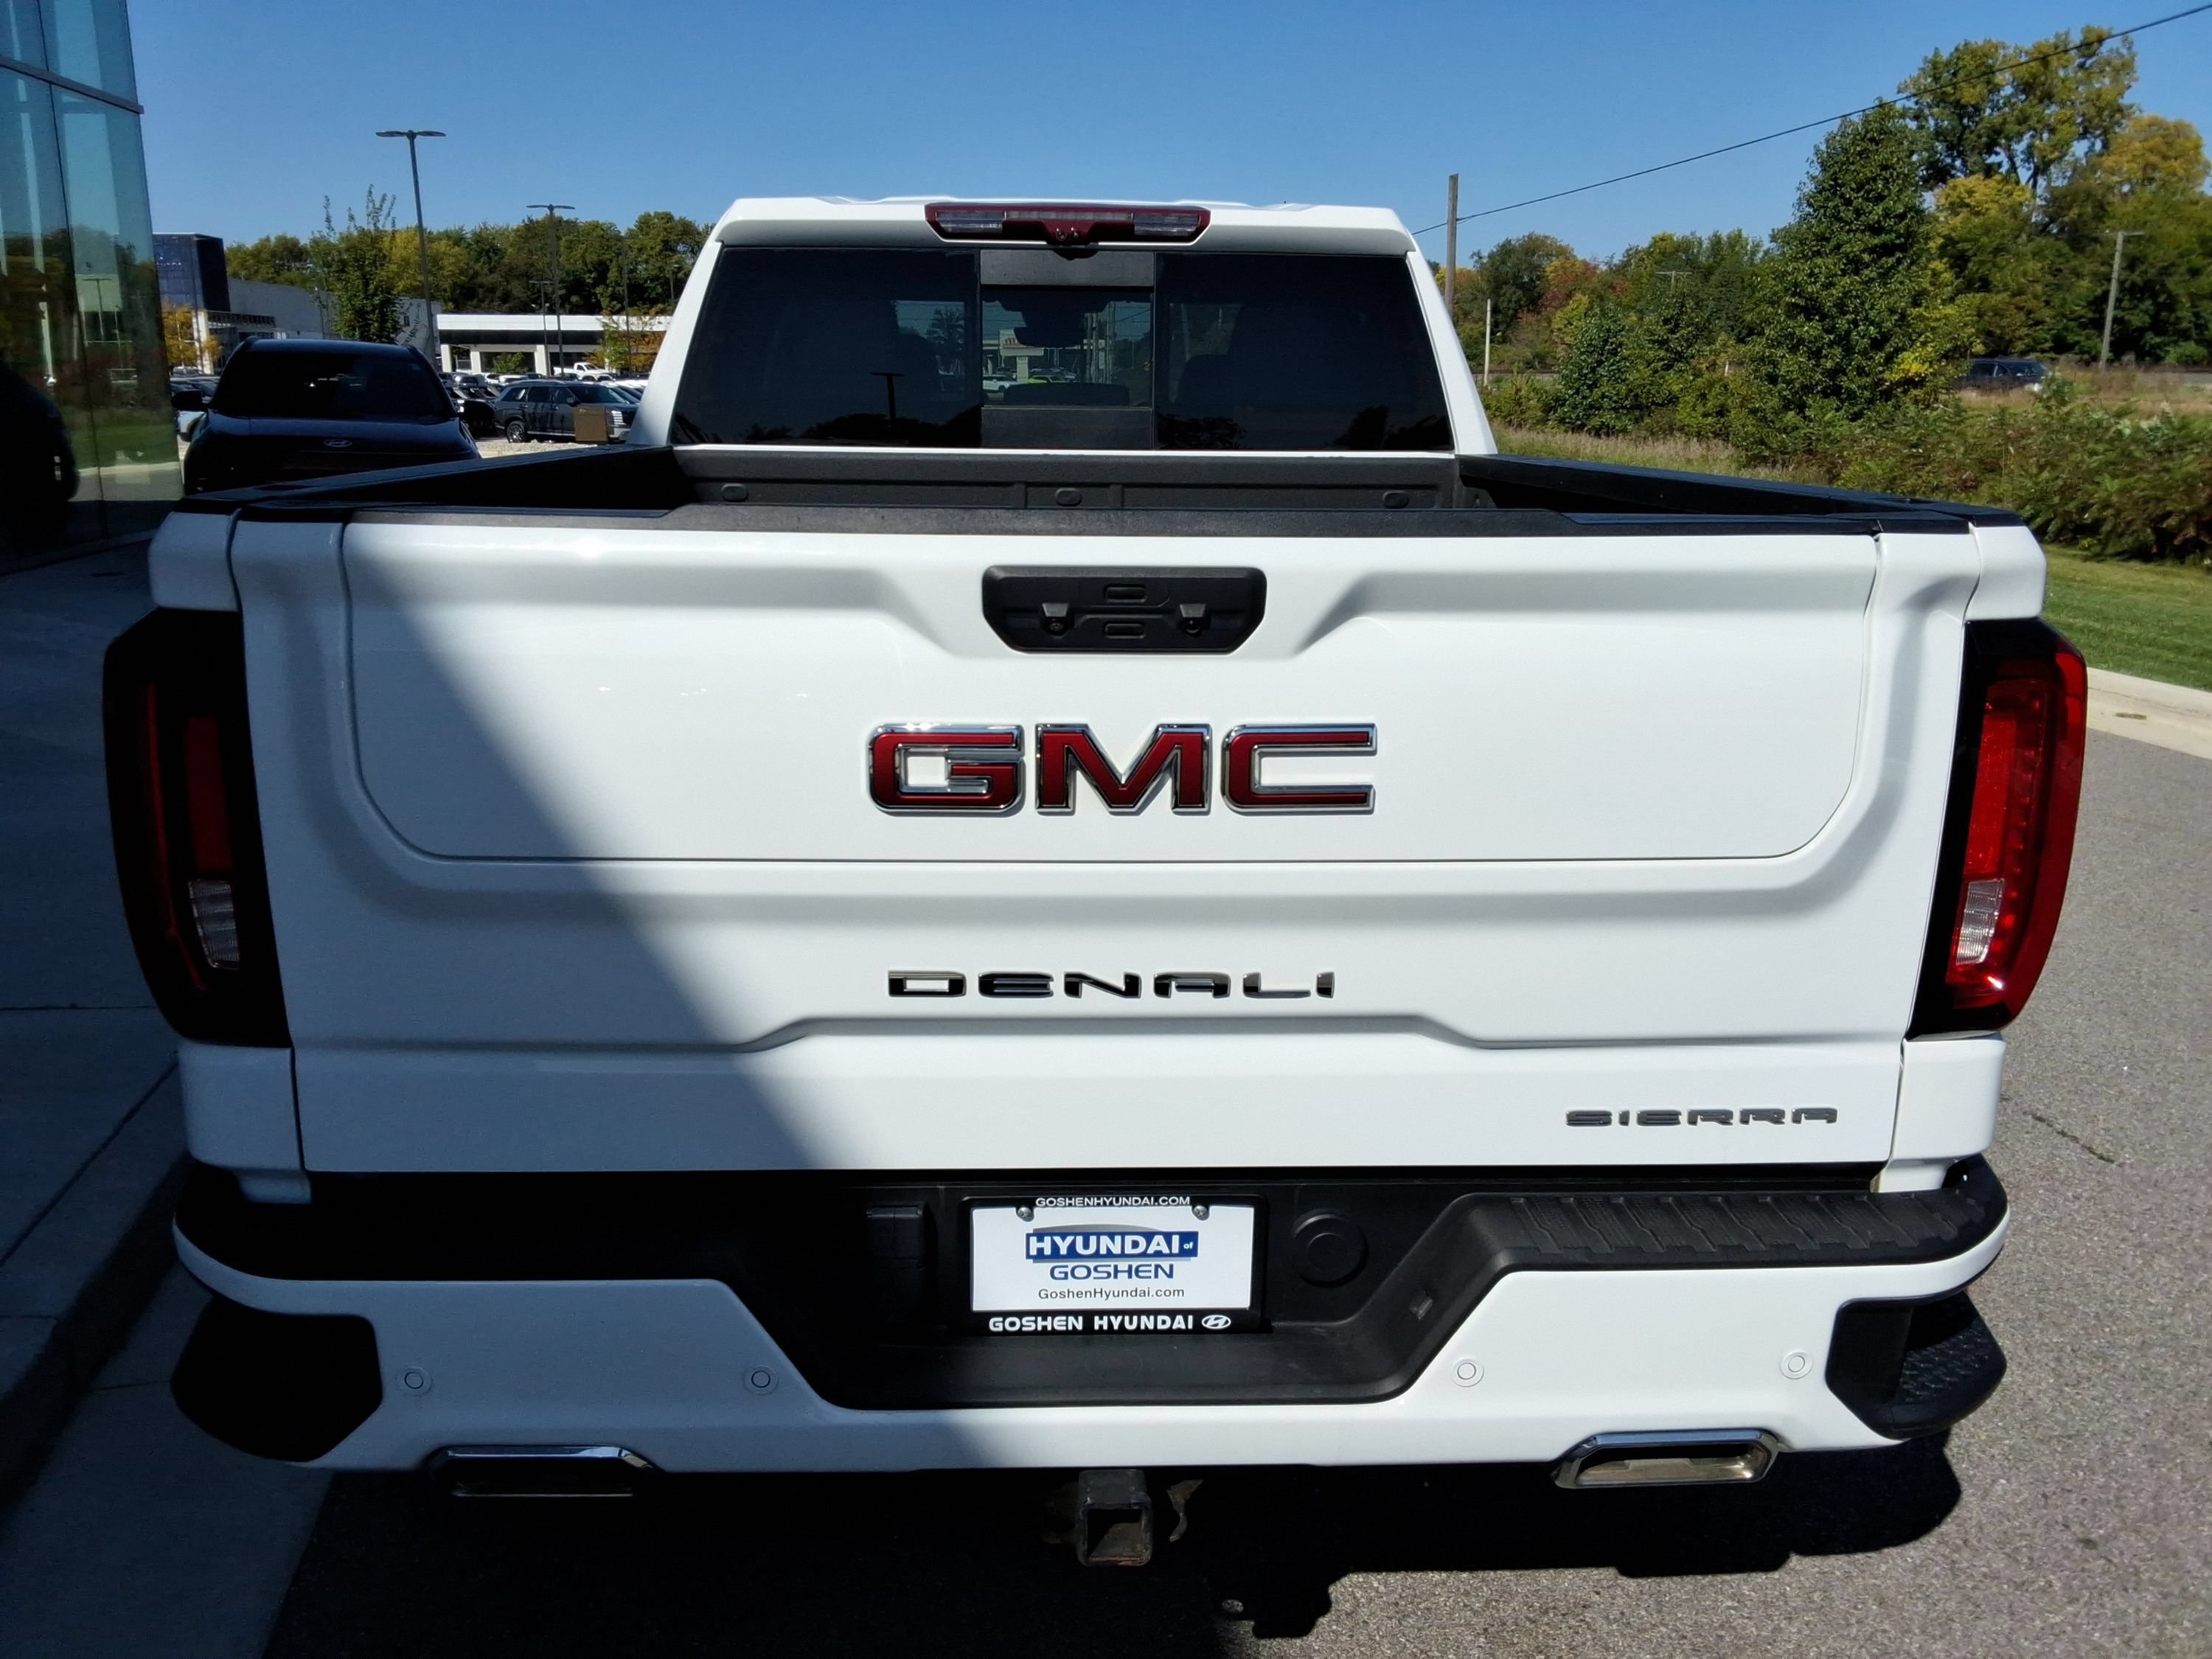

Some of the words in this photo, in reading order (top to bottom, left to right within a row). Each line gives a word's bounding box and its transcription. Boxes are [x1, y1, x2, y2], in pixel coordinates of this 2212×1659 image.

[869, 723, 1377, 815] GMC
[888, 971, 1335, 998] DENALI
[1565, 1107, 1838, 1126] SIERRA
[1035, 1196, 1191, 1207] GOSHENHYUNDAI.COM
[1029, 1235, 1180, 1256] HYUNDAI
[1049, 1264, 1175, 1281] GOSHEN
[1038, 1287, 1185, 1301] GoshenHyundai.com
[989, 1317, 1083, 1332] GOSHEN
[1094, 1315, 1193, 1331] HYUNDAI
